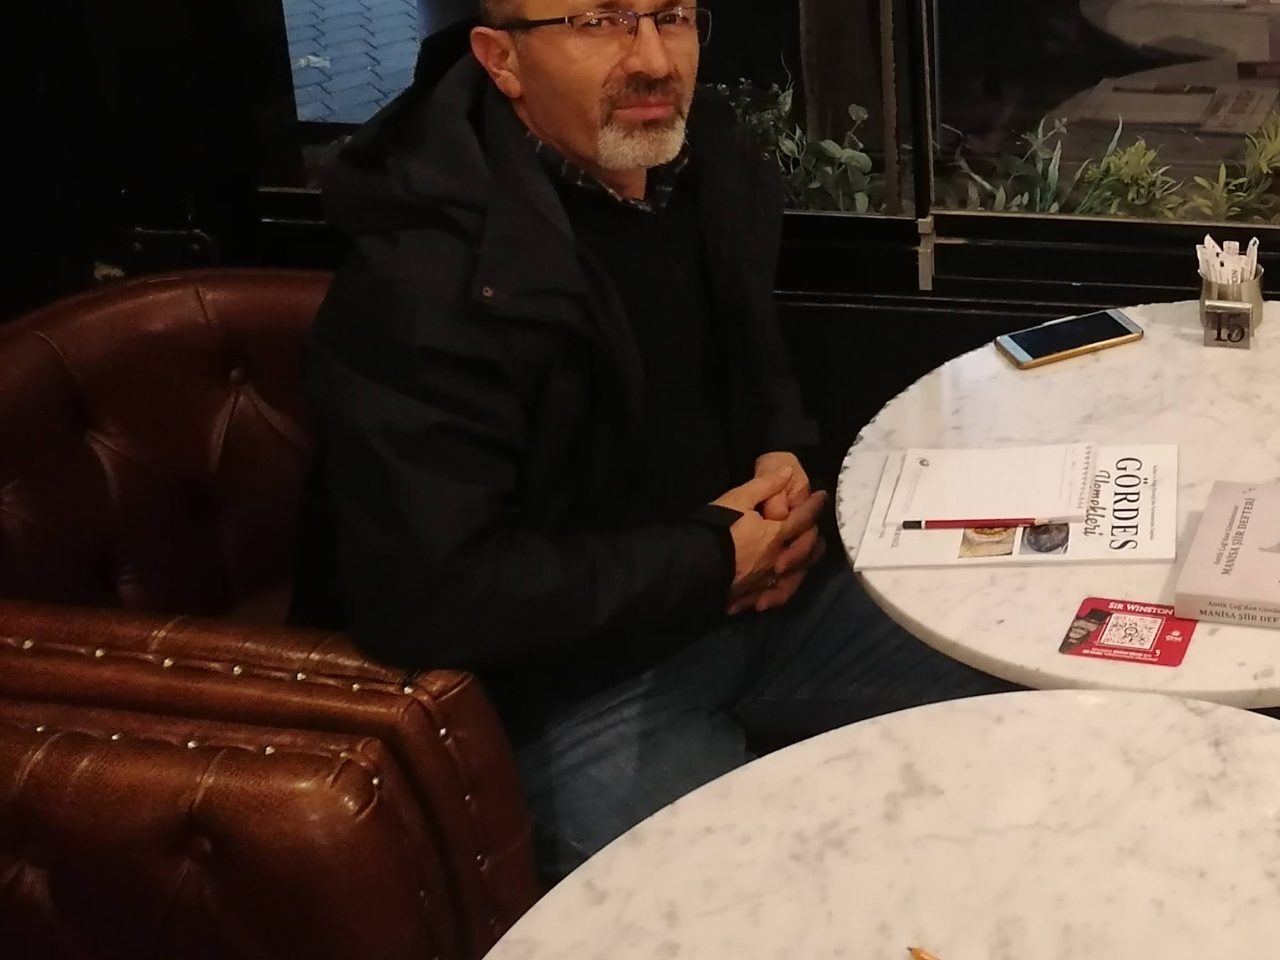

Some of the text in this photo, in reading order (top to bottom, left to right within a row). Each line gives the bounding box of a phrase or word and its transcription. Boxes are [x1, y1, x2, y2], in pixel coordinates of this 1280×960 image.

[1214, 313, 1246, 342] 15
[1109, 457, 1149, 551] GÖRDES
[1108, 601, 1174, 615] SIR WINSTON
[1199, 608, 1236, 620] MANİSA
